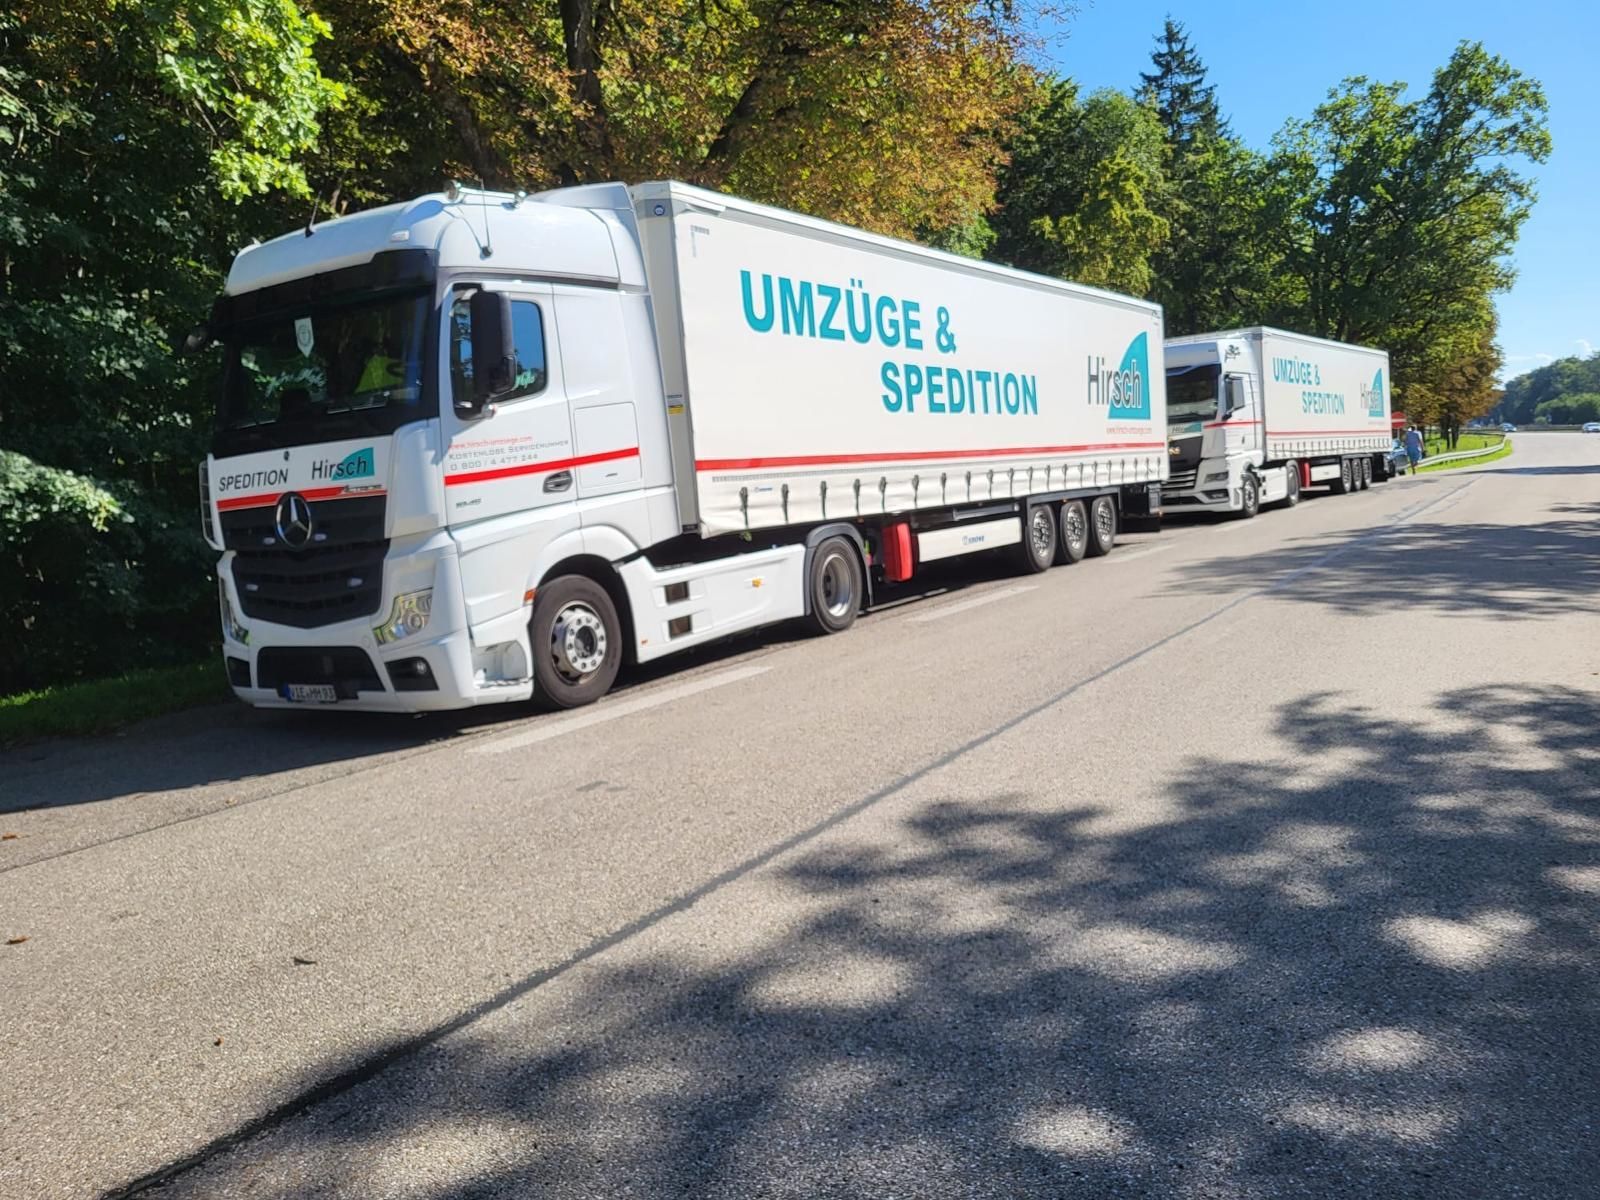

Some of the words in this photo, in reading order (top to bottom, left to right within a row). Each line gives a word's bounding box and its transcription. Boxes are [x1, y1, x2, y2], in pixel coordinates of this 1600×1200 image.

[739, 269, 925, 352] UMZÜGE
[935, 305, 958, 355] &
[1088, 356, 1143, 409] Hirsch
[1314, 364, 1322, 386] &
[881, 361, 1039, 416] SPEDITION
[1302, 391, 1345, 414] SPEDITION
[311, 455, 368, 481] Hirsch
[461, 461, 481, 470] 800
[500, 456, 518, 464] 477
[218, 468, 289, 492] SPEDITION
